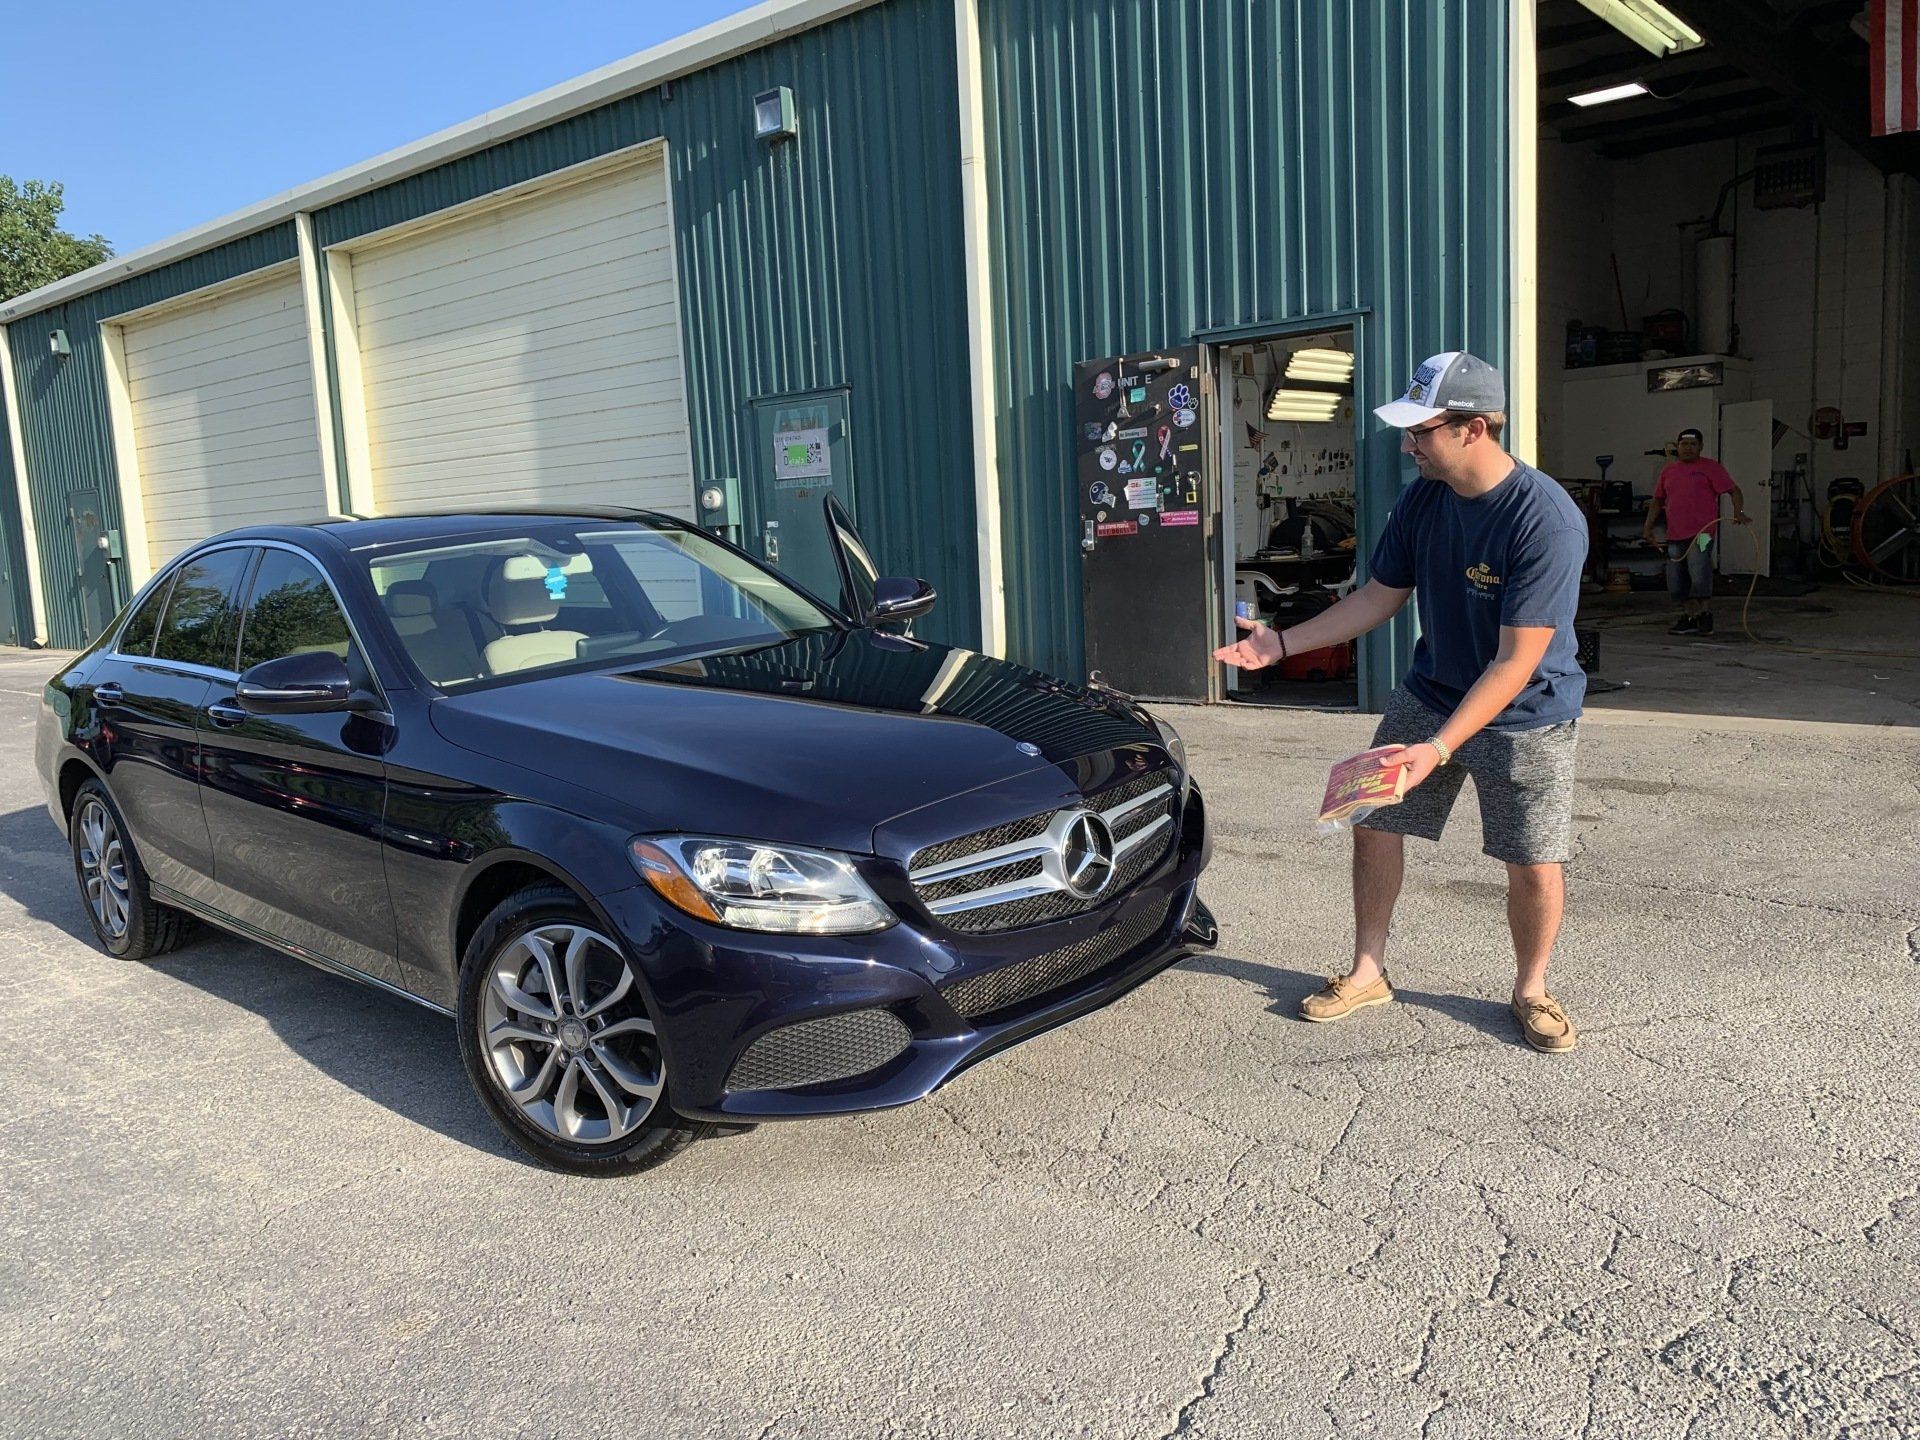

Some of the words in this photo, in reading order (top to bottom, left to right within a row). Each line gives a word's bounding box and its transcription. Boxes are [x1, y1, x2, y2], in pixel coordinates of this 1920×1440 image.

[1118, 376, 1138, 387] UNIT
[1145, 374, 1152, 384] E
[1448, 399, 1475, 408] Reebok
